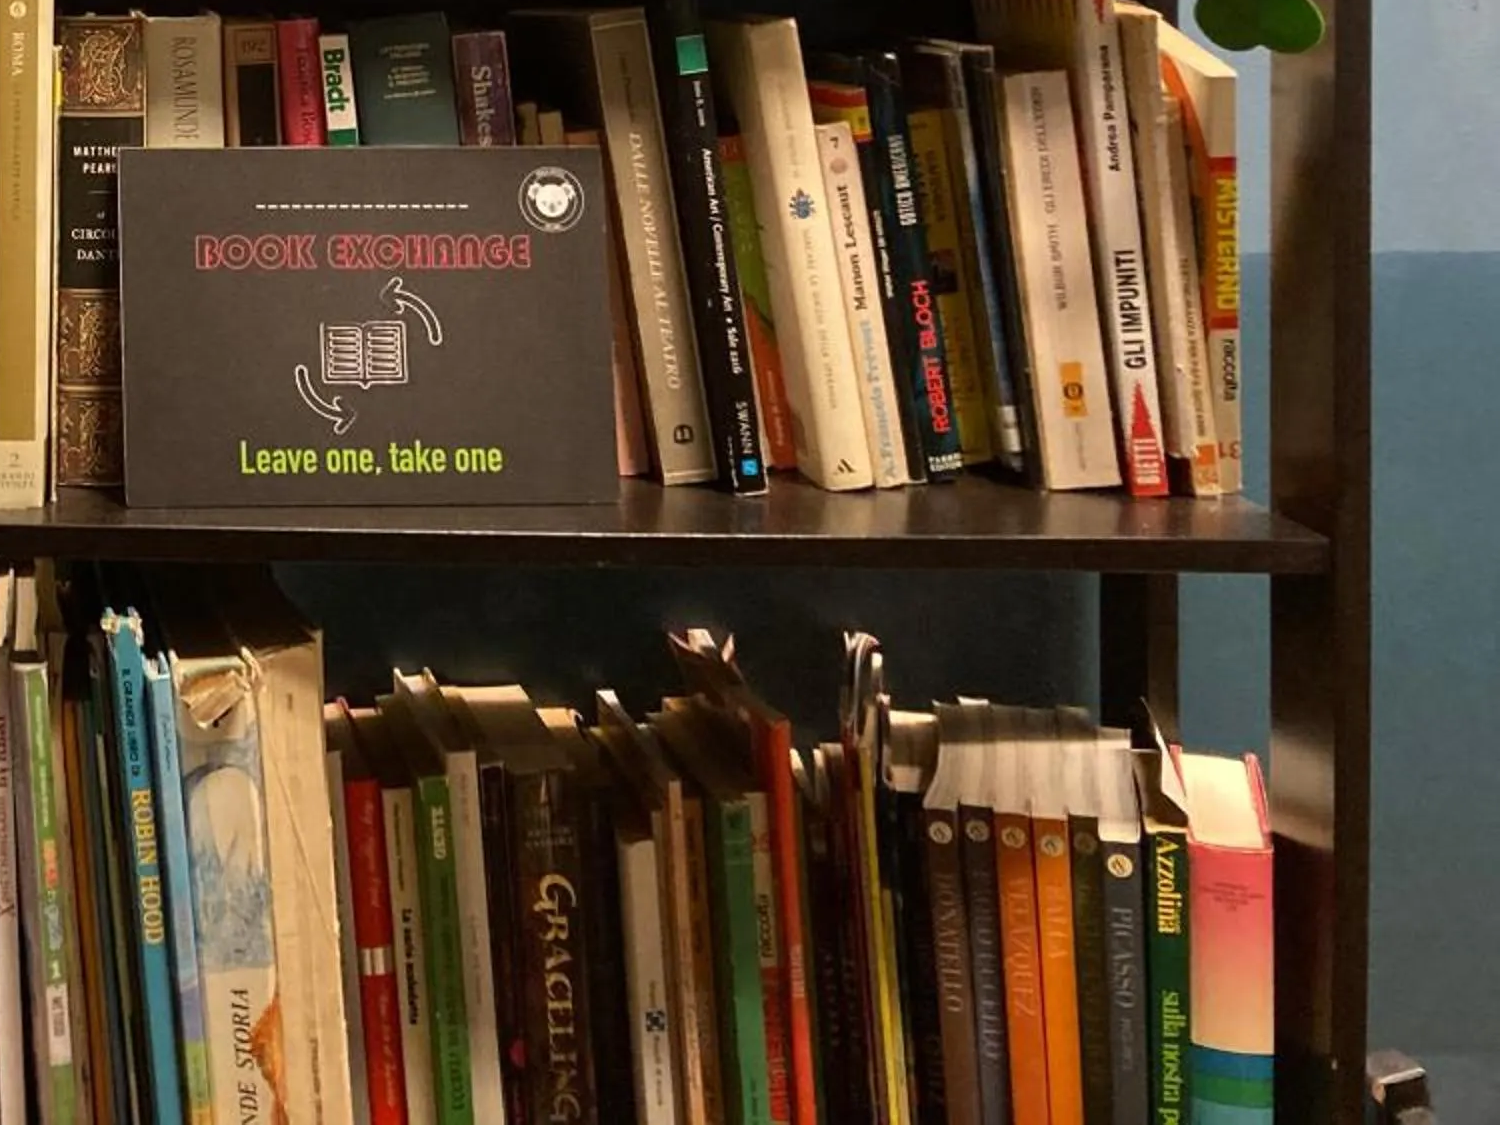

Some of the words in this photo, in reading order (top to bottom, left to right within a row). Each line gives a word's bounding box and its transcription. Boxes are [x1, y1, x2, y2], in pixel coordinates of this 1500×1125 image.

[11, 31, 25, 76] ROMA
[323, 48, 350, 113] Bradt
[171, 35, 199, 141] ROSAMUNDE
[471, 66, 496, 147] Shakes
[73, 146, 118, 157] MATTHE
[628, 132, 651, 194] DALLE
[701, 148, 717, 195] American
[1104, 125, 1122, 172] Andrea
[71, 228, 116, 240] CIRCO
[708, 198, 719, 215] Art
[836, 184, 858, 248] Lescaut
[76, 248, 118, 261] DANT
[195, 234, 318, 270] BOOK
[327, 233, 532, 269] EXCHANGE
[637, 196, 663, 282] NOVELLE
[711, 224, 733, 294] Contemporary
[651, 284, 667, 315] AL
[723, 296, 733, 312] Art
[850, 255, 868, 311] Manon
[1113, 249, 1143, 333] IMPUNITI
[910, 280, 936, 349] BLOCH
[658, 317, 682, 390] TEATRO
[1124, 337, 1148, 369] GLI
[1222, 338, 1237, 401] raccolta
[922, 355, 950, 434] ROBERT
[240, 440, 318, 475] Leave
[326, 447, 382, 476] one,
[389, 441, 446, 472] take
[454, 446, 504, 473] one
[735, 401, 754, 455] SWANN
[1133, 438, 1160, 485] BIETTI
[122, 681, 136, 728] GRANDE
[127, 731, 139, 763] LIBRO
[131, 788, 157, 865] ROBIN
[139, 875, 164, 945] HOOD
[1156, 835, 1182, 935] Azzolina
[934, 872, 964, 1012] DONATELLO
[1110, 907, 1141, 1008] PICASSO
[532, 873, 582, 1122] GRACELING
[1161, 990, 1186, 1037] sulla
[229, 988, 254, 1070] STORIA
[238, 1081, 258, 1125] NDE
[1161, 1043, 1186, 1103] nostra
